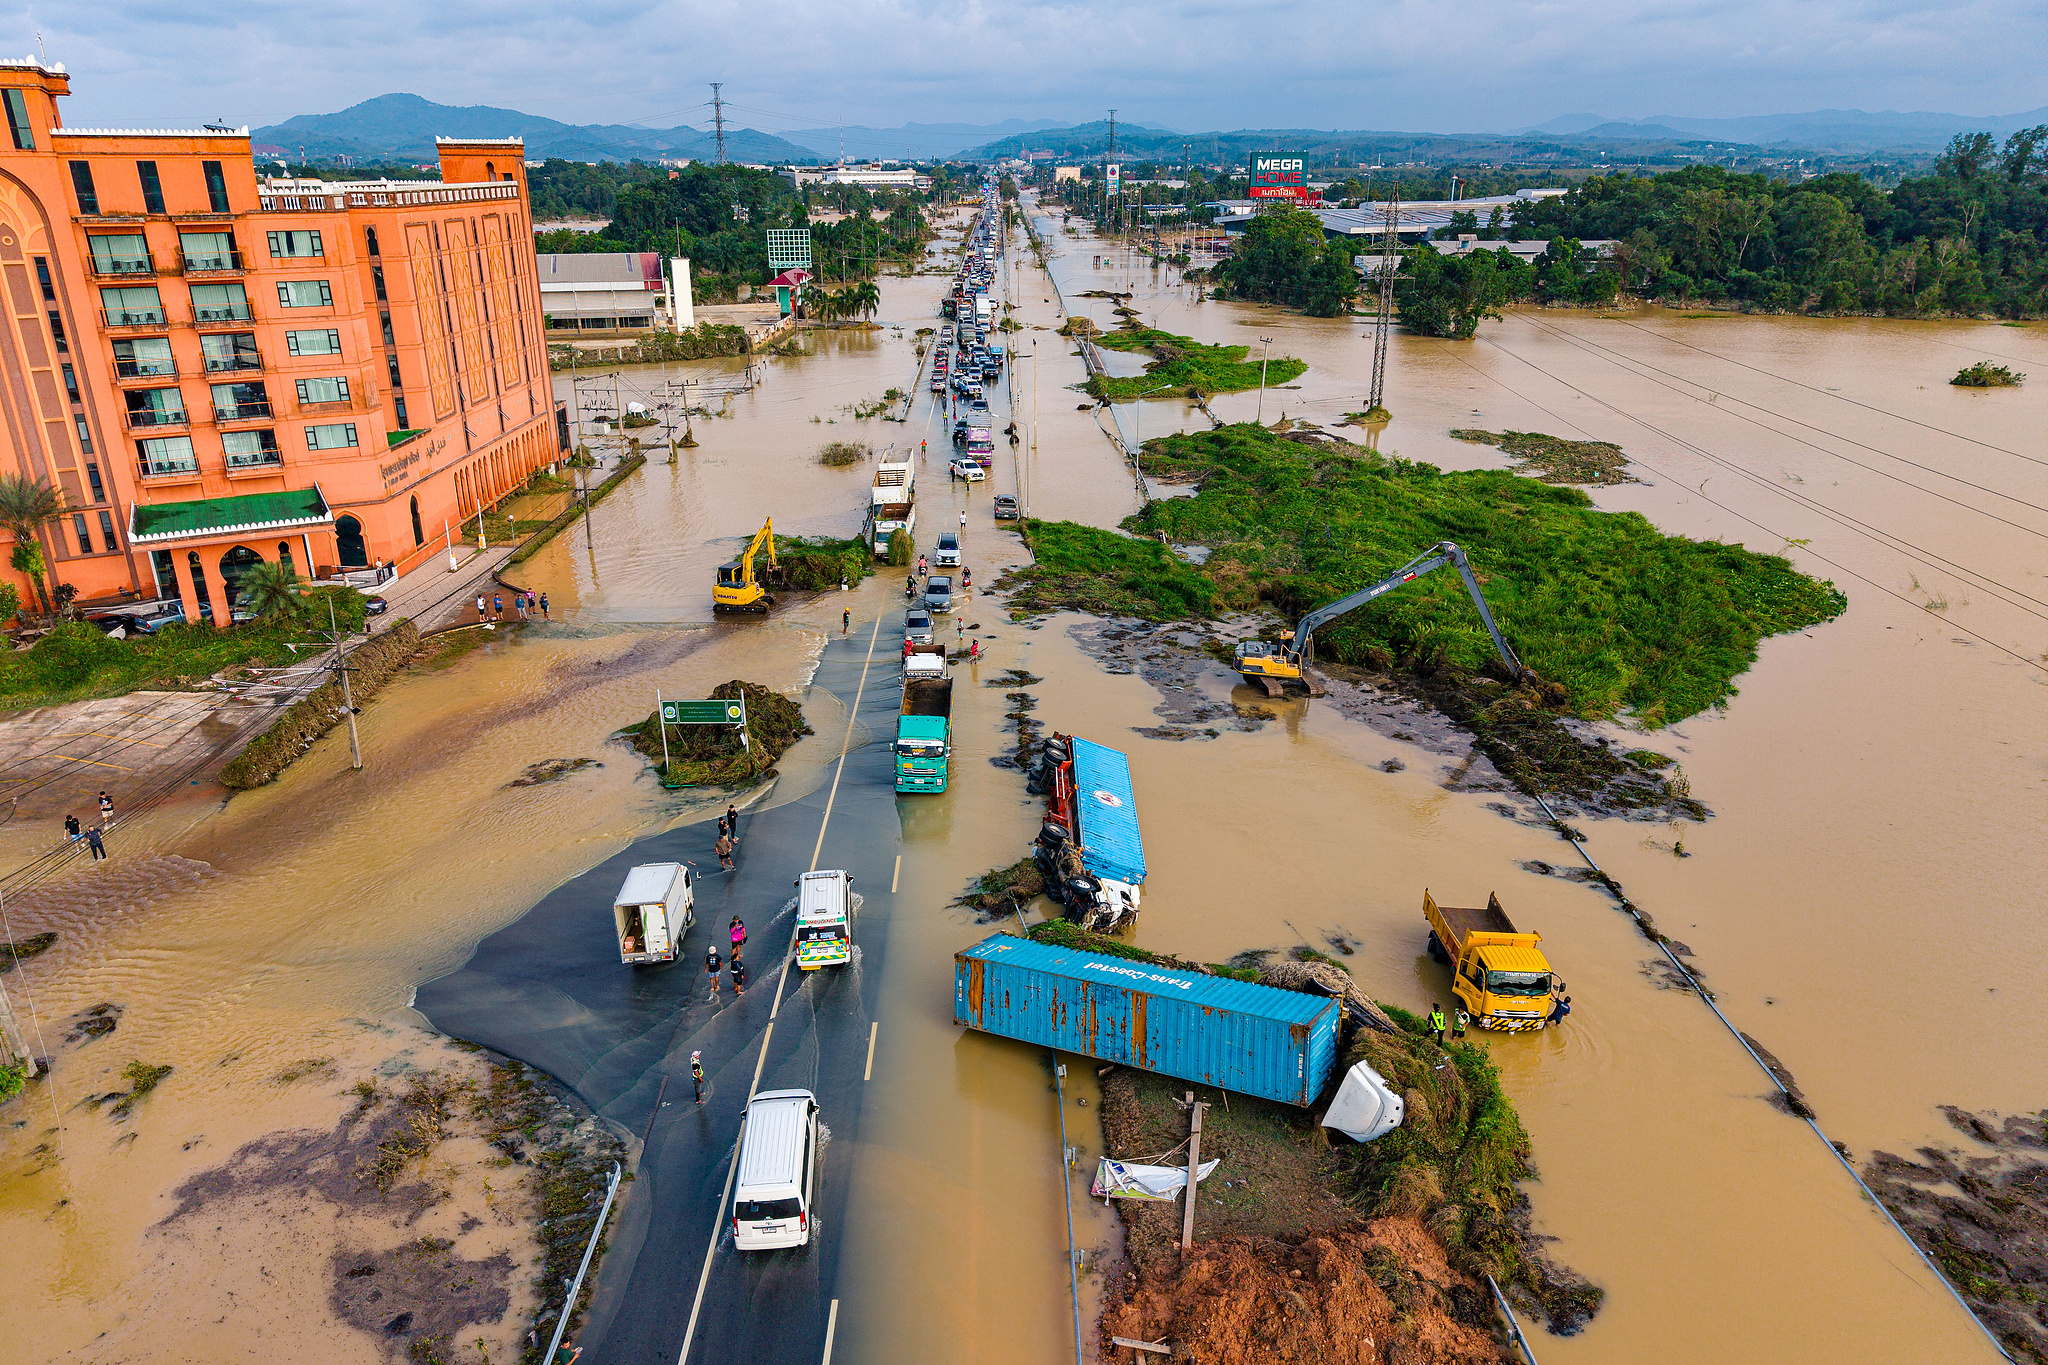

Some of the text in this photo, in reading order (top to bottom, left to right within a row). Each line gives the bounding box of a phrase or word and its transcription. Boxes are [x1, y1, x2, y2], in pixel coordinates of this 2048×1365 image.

[1257, 159, 1303, 171] MEGA
[1256, 171, 1302, 183] HOME
[1083, 961, 1193, 990] Trans-Coastal
